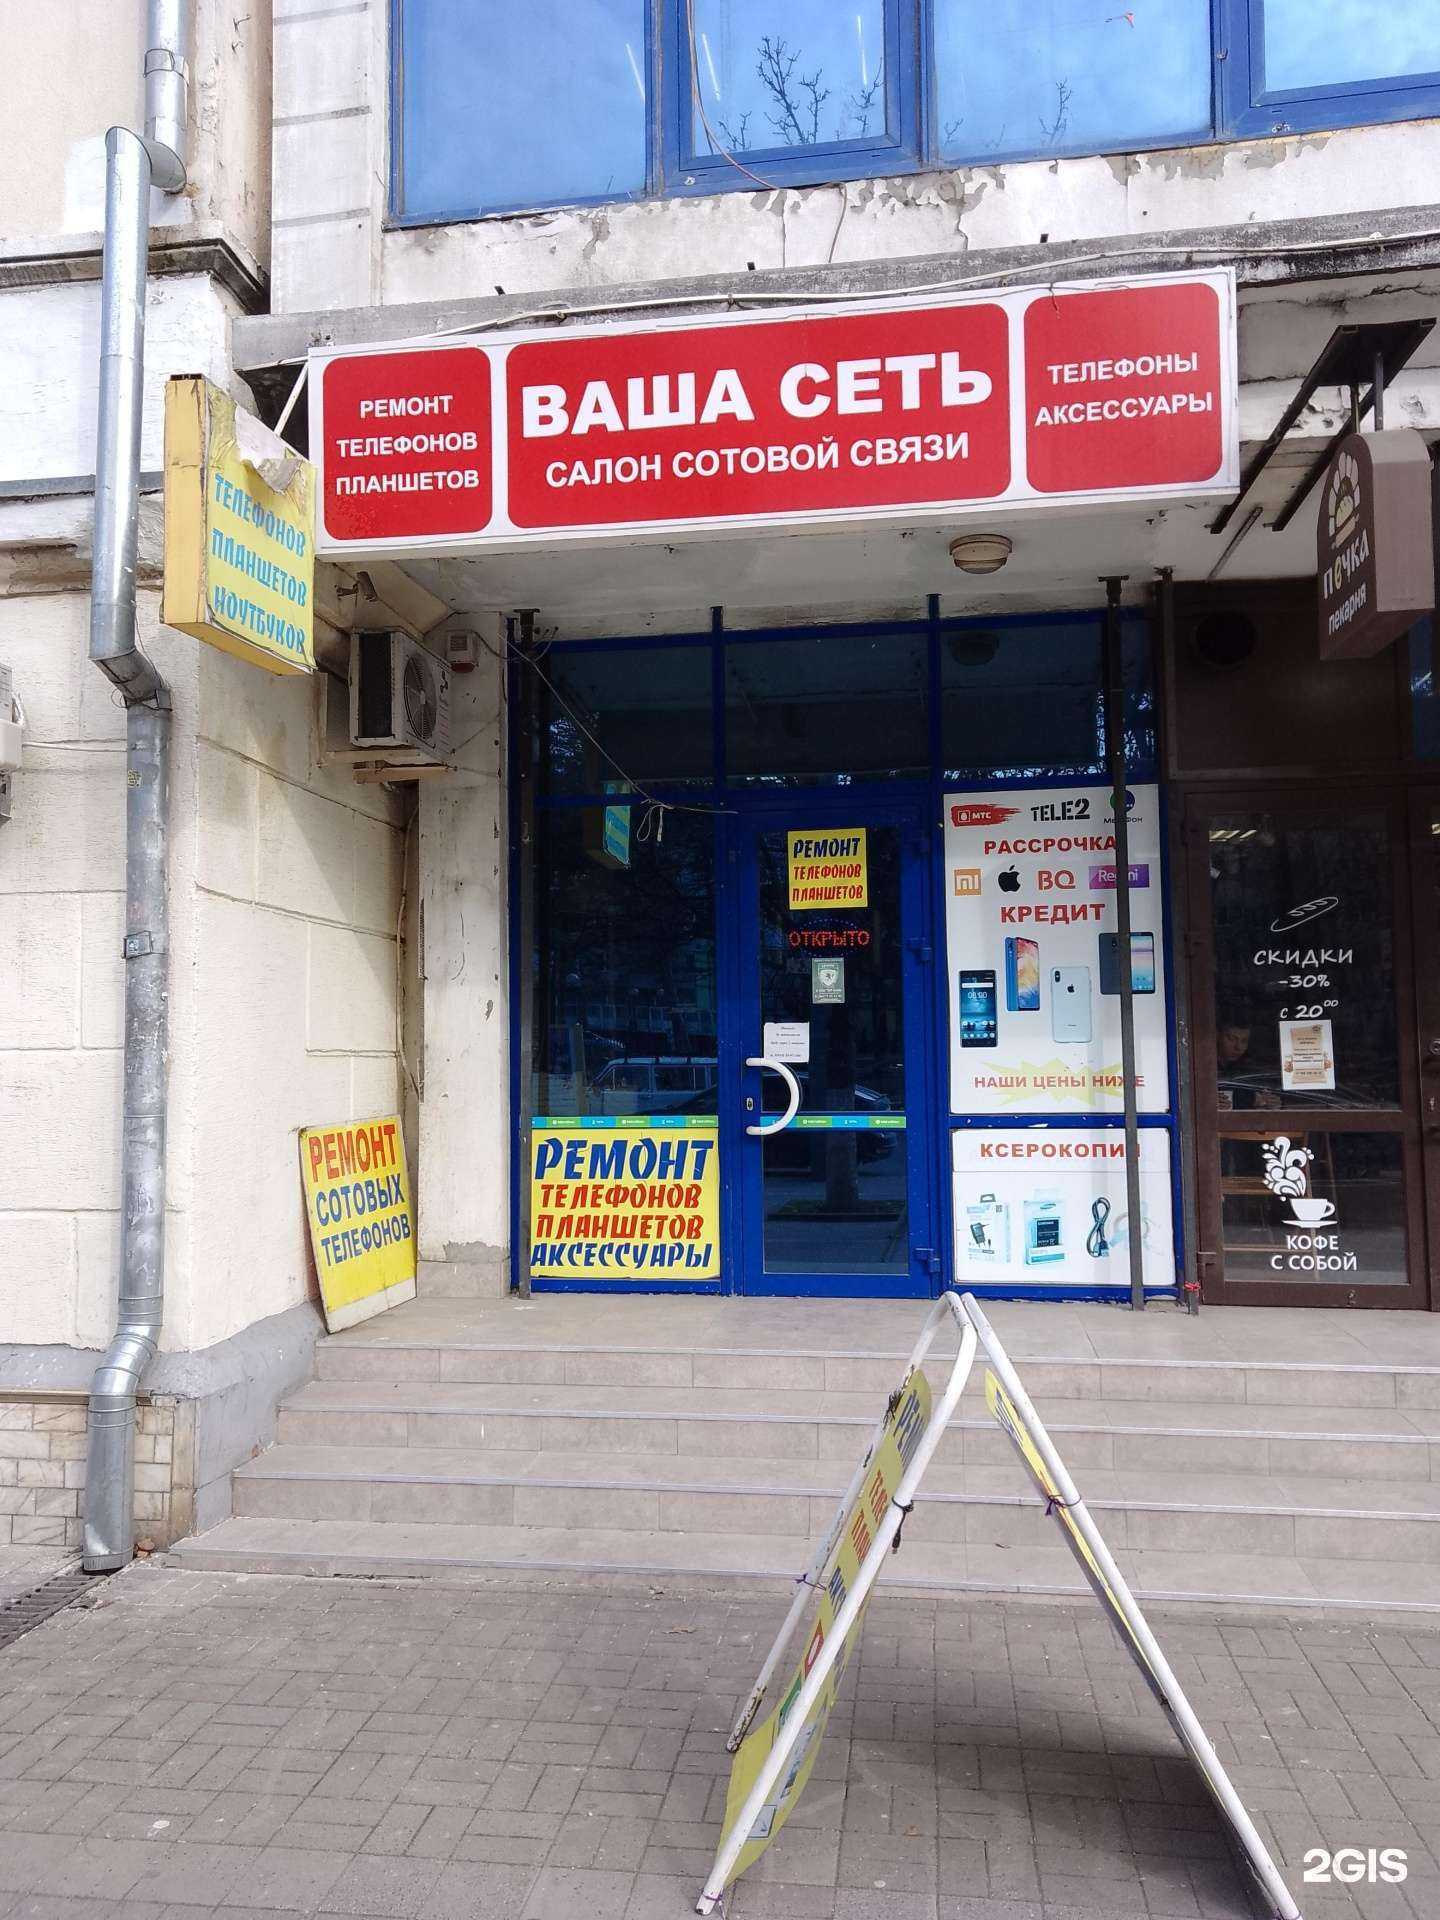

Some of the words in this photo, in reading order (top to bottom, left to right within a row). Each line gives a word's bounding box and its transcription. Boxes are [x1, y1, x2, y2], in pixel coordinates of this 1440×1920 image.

[1047, 352, 1198, 385] ТЕЛЕФОНЫ
[360, 395, 453, 419] РЕМОНТ
[522, 369, 755, 439] ВАША
[779, 351, 993, 419] СЕТЬ
[1034, 392, 1212, 427] АКСЕССУАРЫ
[336, 432, 478, 458] ТЕЛЕФОНОВ
[545, 453, 661, 488] САЛОН
[671, 435, 839, 479] СОТОВОЙ
[850, 432, 969, 467] СВЯЗИ
[336, 469, 479, 495] ПЛАНШЕТОВ
[214, 472, 306, 558] ТЕЛЕФОНОВ
[212, 528, 307, 607] ПЛАНШЕТОВ
[214, 584, 306, 655] НОУТБУКОВ
[1328, 582, 1367, 636] пекарня
[972, 811, 992, 820] МТС
[1030, 798, 1090, 821] TELE2
[793, 837, 861, 859] РЕМОНТ
[984, 835, 1117, 855] РАССРОЧКА
[793, 863, 862, 880] ТЕЛЕФОНОВ
[1037, 869, 1076, 891] BQ
[792, 884, 864, 902] ПЛАНШЕТОВ
[1001, 903, 1106, 925] КРЕДИТ
[788, 930, 870, 947] ОТКРЫТО
[1253, 948, 1353, 969] СКИДКИ
[1277, 974, 1331, 988] -30%
[974, 1075, 1027, 1089] НАШИ
[1033, 1075, 1086, 1090] ЦЕНЫ
[308, 1123, 396, 1183] РЕМОНТ
[534, 1137, 714, 1180] РЕМОНТ
[980, 1143, 1141, 1158] КСЕРОКОПИ
[316, 1173, 406, 1227] СОТОВЫХ
[540, 1183, 702, 1209] ТЕЛЕФОНОВ
[321, 1213, 411, 1267] ТЕЛЕФОНОВ
[536, 1214, 704, 1240] ПЛАНШЕТОВ
[530, 1242, 713, 1269] АКСЕССУАРЫ
[1286, 1235, 1339, 1250] КОФЕ
[1271, 1255, 1283, 1270] С
[1289, 1252, 1357, 1271] СОБОЙ
